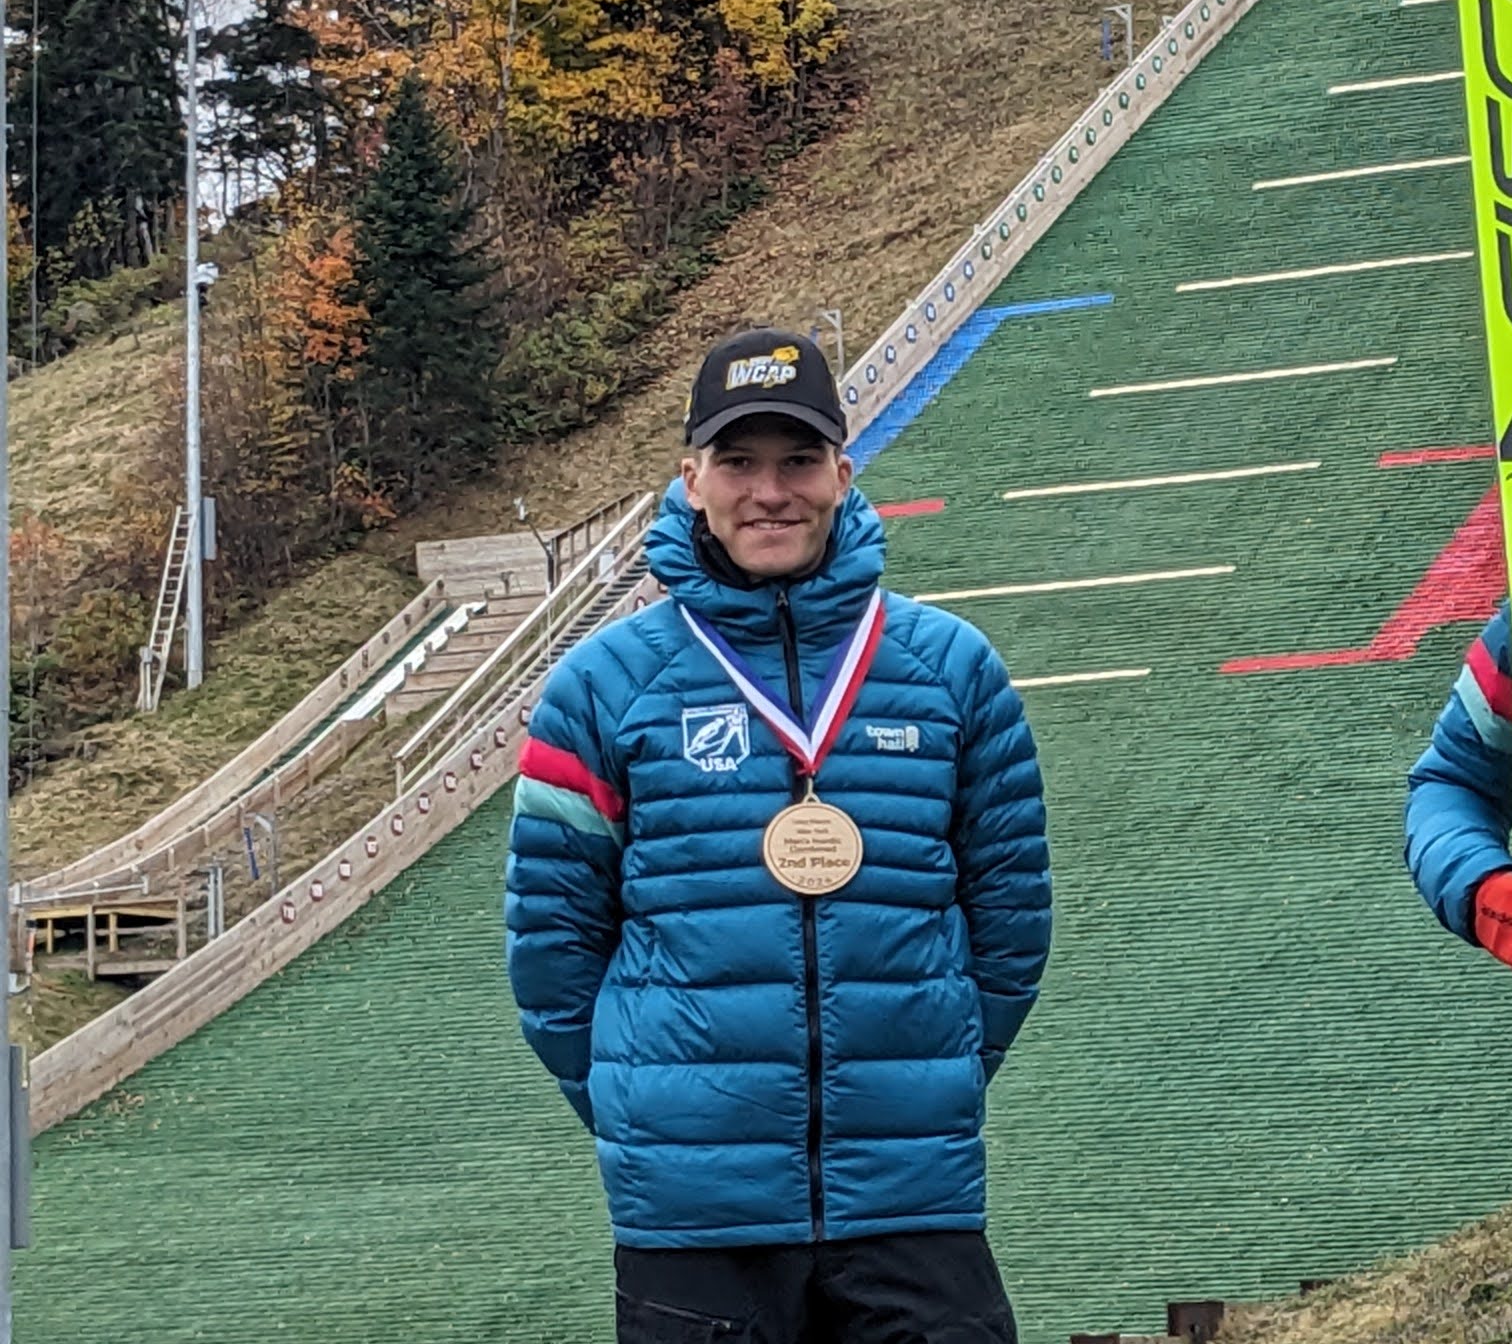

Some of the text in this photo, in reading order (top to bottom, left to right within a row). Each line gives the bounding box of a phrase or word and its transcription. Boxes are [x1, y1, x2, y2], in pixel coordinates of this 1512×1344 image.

[729, 359, 797, 387] WCAP
[866, 725, 905, 737] town
[700, 756, 738, 772] USA
[778, 857, 850, 868] 2nd Place
